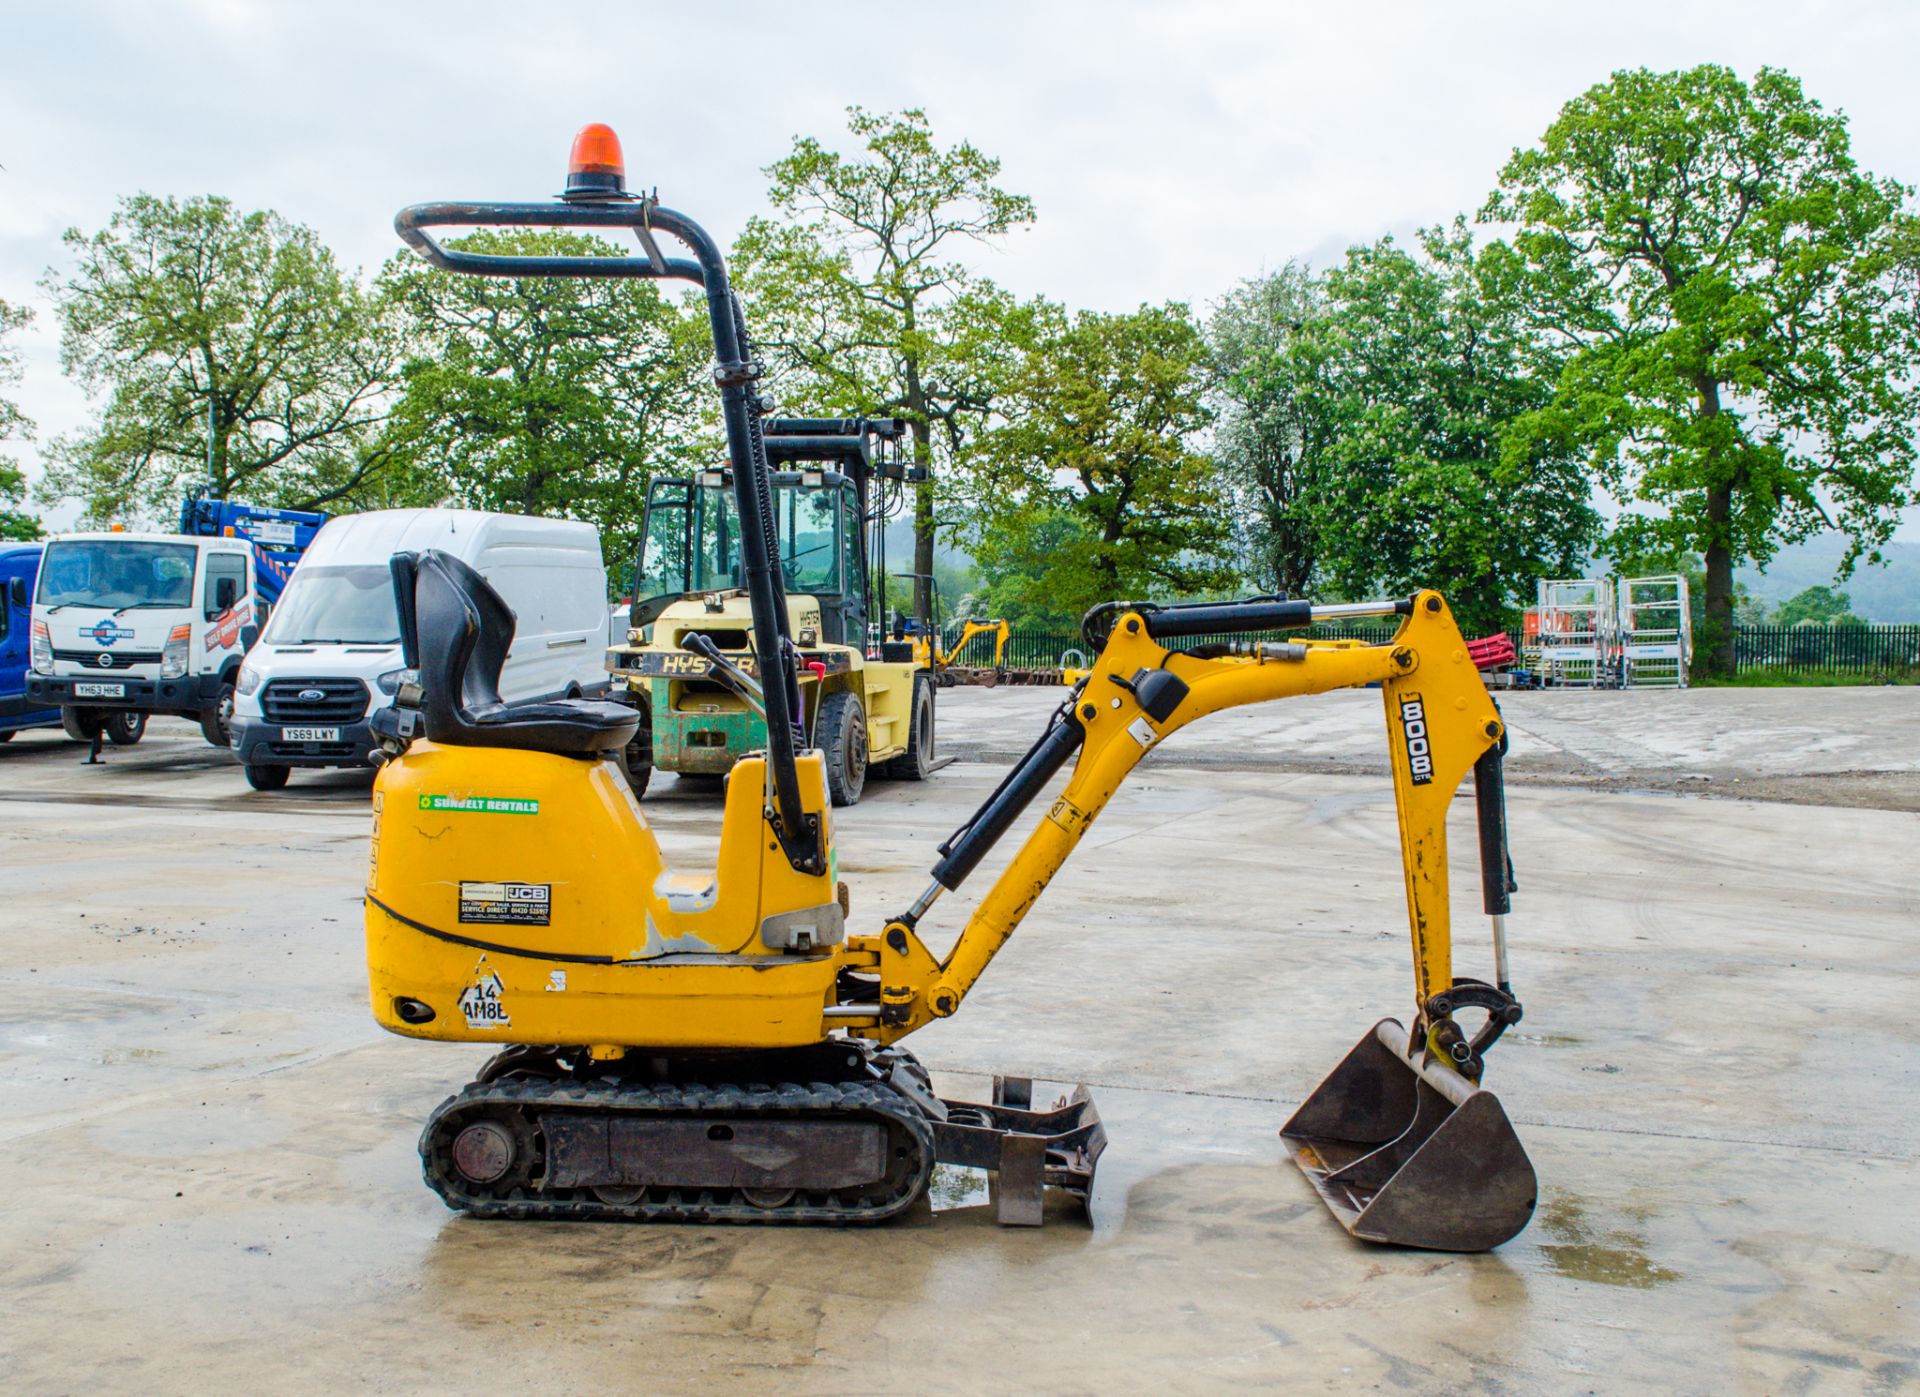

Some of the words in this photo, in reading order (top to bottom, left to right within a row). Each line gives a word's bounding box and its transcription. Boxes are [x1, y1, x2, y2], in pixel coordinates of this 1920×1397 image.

[800, 610, 820, 627] HYSTER
[662, 656, 754, 674] HYSR
[79, 683, 102, 695] YH63
[103, 684, 121, 696] HHE
[286, 729, 312, 740] YS69
[314, 729, 334, 740] LWY
[1402, 702, 1432, 775] 8008
[486, 800, 539, 812] RENTALS
[508, 887, 545, 899] JCB
[475, 983, 497, 1001] 14
